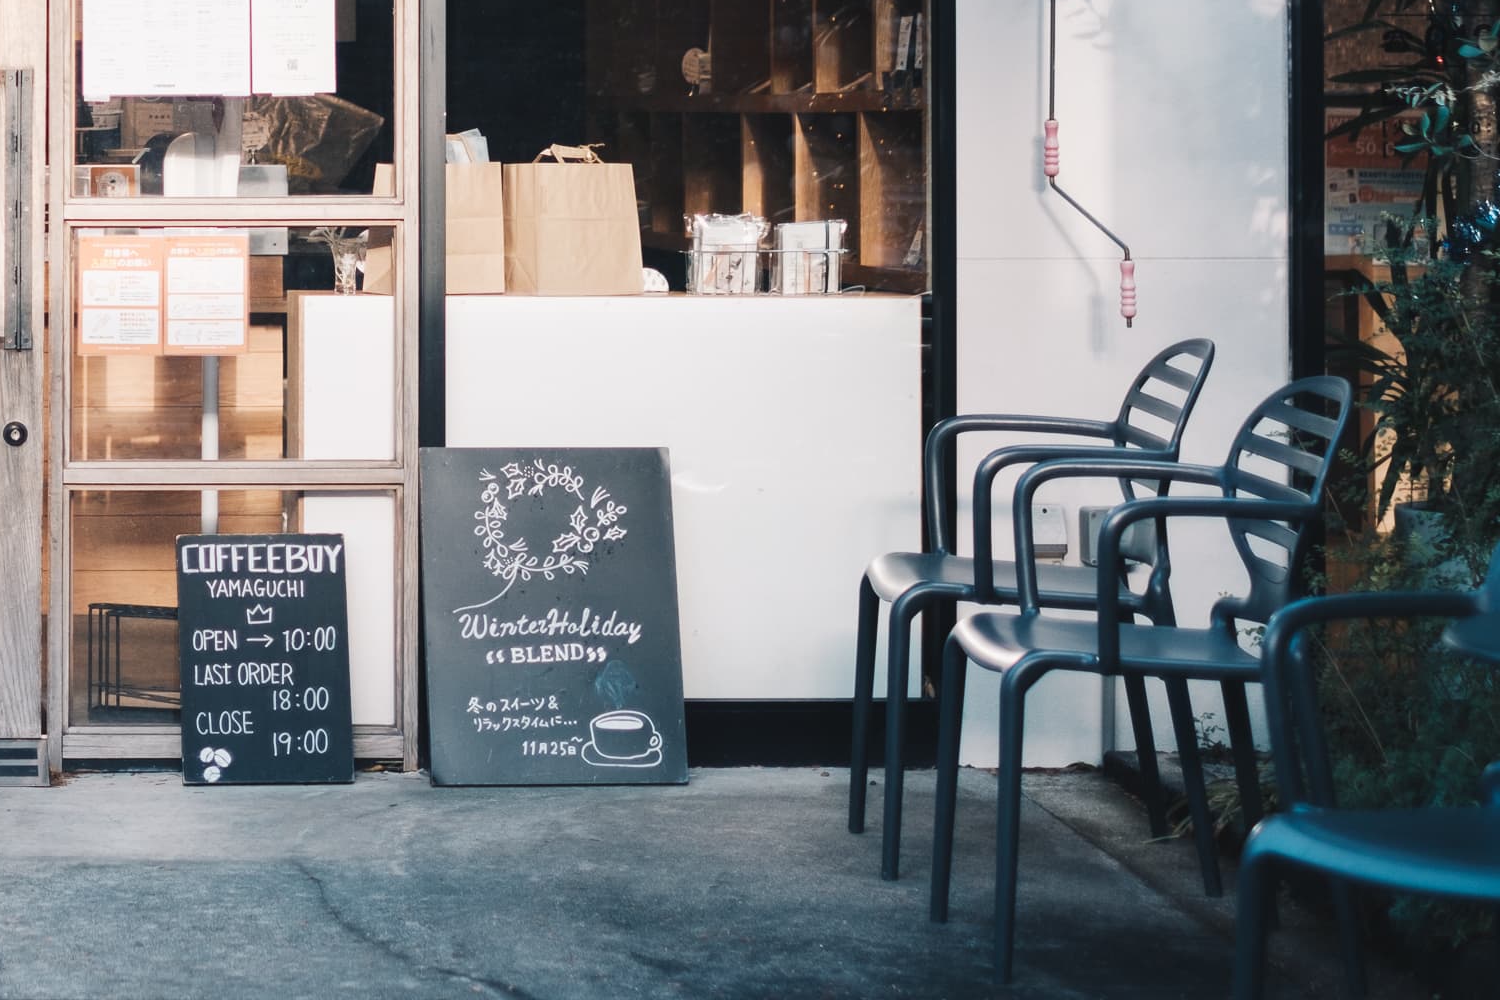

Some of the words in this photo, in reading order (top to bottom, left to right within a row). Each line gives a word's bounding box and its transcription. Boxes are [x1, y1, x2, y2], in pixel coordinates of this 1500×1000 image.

[181, 543, 343, 574] COFFEEBOY
[206, 579, 306, 599] YAMAGUCHI
[192, 629, 238, 651] OPEN
[282, 626, 337, 653] 10:00
[237, 662, 295, 686] ORDER
[272, 686, 330, 711] 18:00
[196, 710, 254, 735] CLOSE
[272, 728, 329, 757] 19:00
